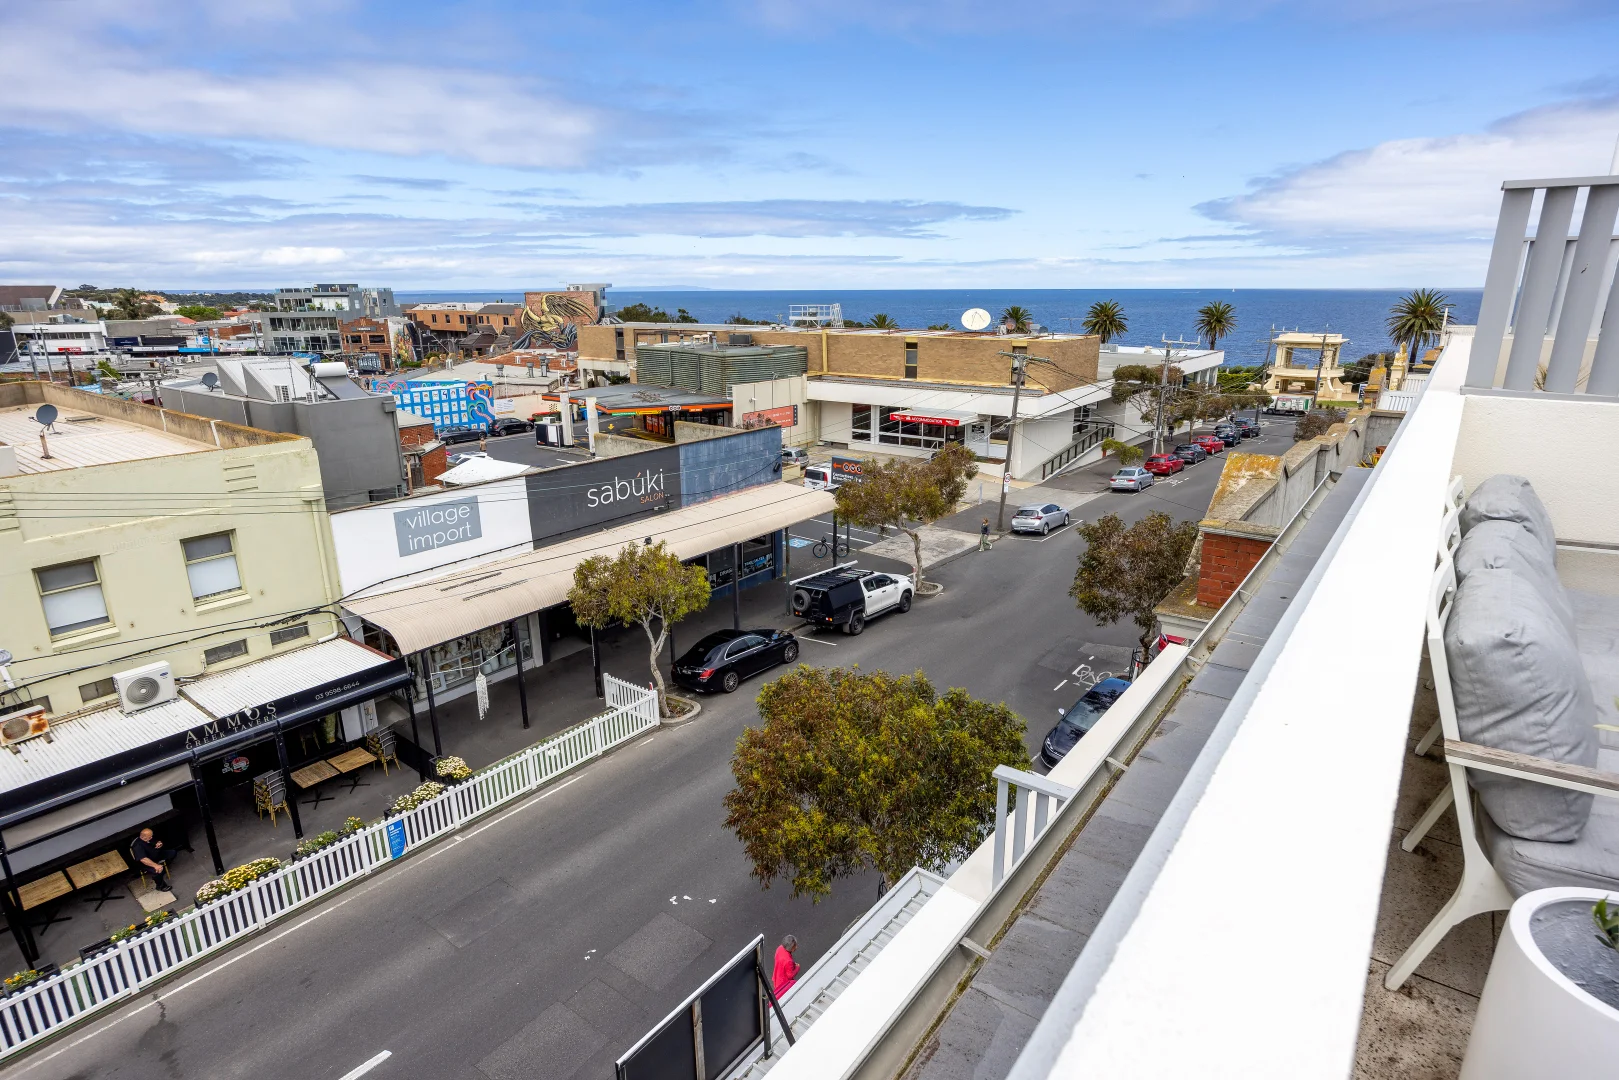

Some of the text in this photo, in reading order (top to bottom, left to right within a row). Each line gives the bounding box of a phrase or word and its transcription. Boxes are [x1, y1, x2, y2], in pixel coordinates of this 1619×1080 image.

[587, 468, 664, 507] sabúki
[640, 492, 664, 504] SALON
[406, 504, 470, 529] village
[408, 521, 472, 550] import
[315, 692, 324, 700] 03
[185, 702, 277, 743] AMMOS
[185, 713, 278, 750] GREEK TAVERN
